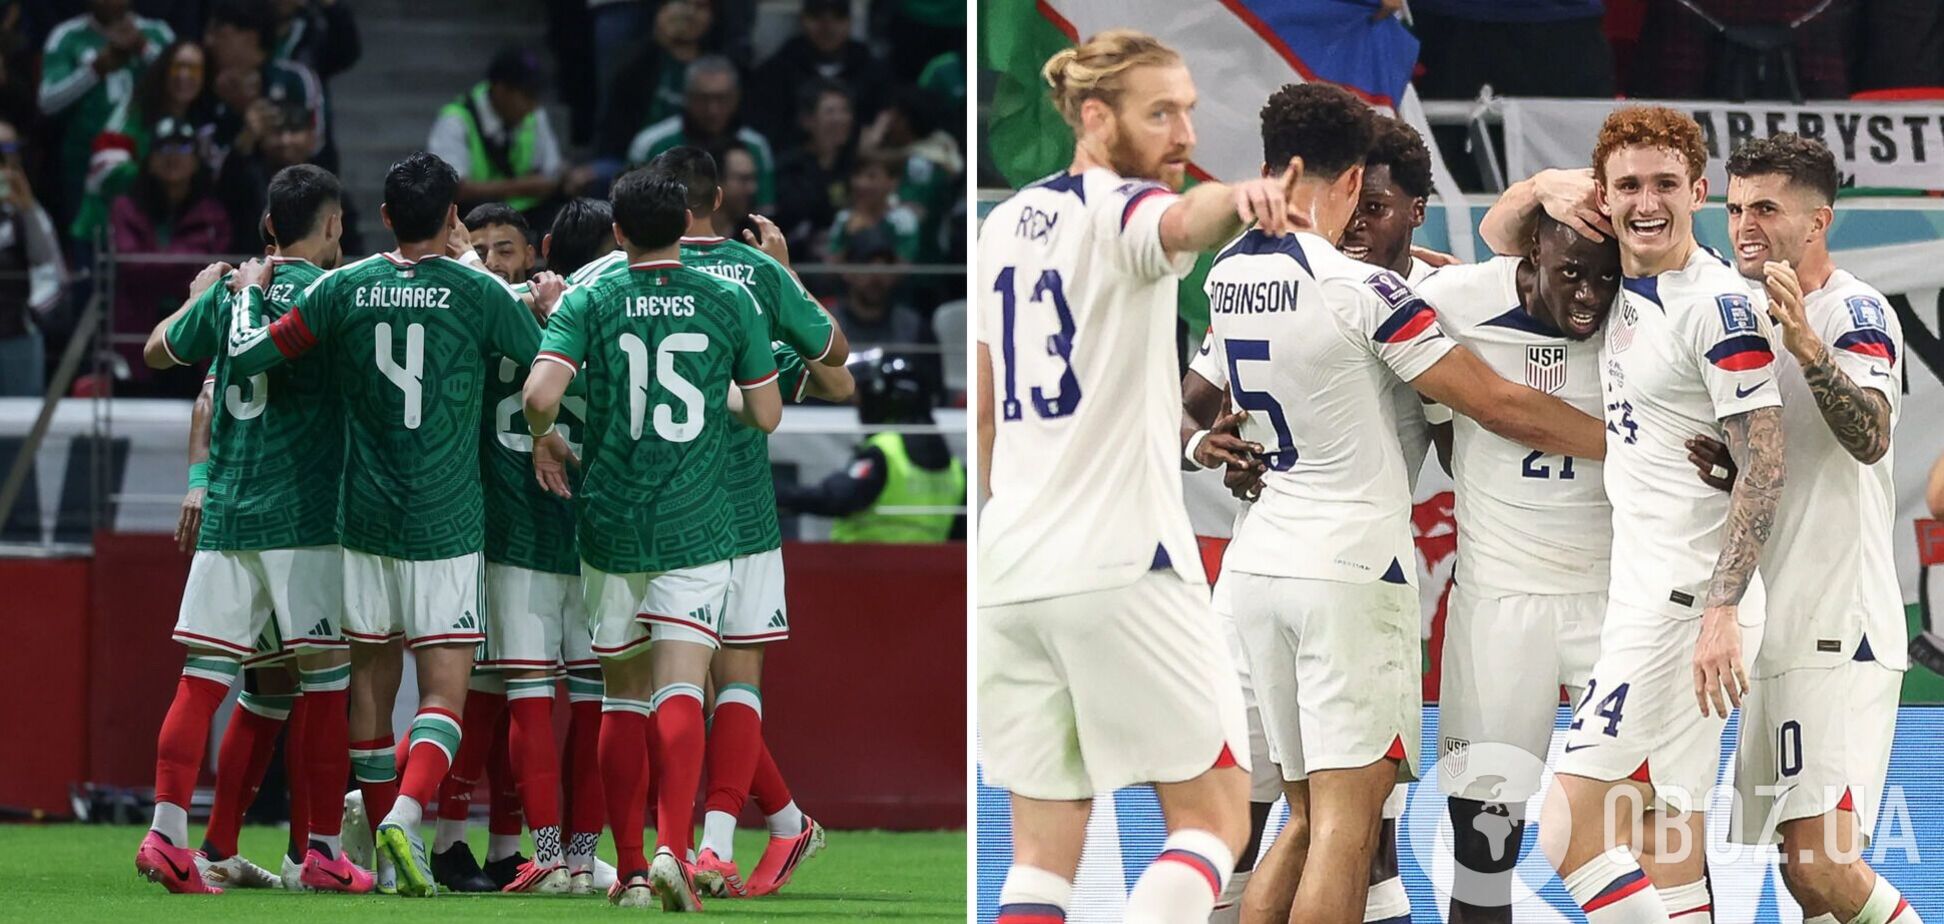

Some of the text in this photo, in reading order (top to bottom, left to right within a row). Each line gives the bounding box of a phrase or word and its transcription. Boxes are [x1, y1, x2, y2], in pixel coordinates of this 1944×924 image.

[1693, 111, 1944, 164] ABRYST
[625, 295, 696, 318] I.REYES
[1623, 303, 1639, 327] US
[993, 265, 1082, 421] 13
[1529, 347, 1564, 367] USA
[375, 321, 425, 430] 4
[618, 332, 710, 443] 15
[1224, 338, 1300, 472] 5
[1521, 449, 1575, 480] 21
[1570, 678, 1630, 738] 24
[1446, 740, 1468, 756] USA
[1775, 719, 1803, 780] 0
